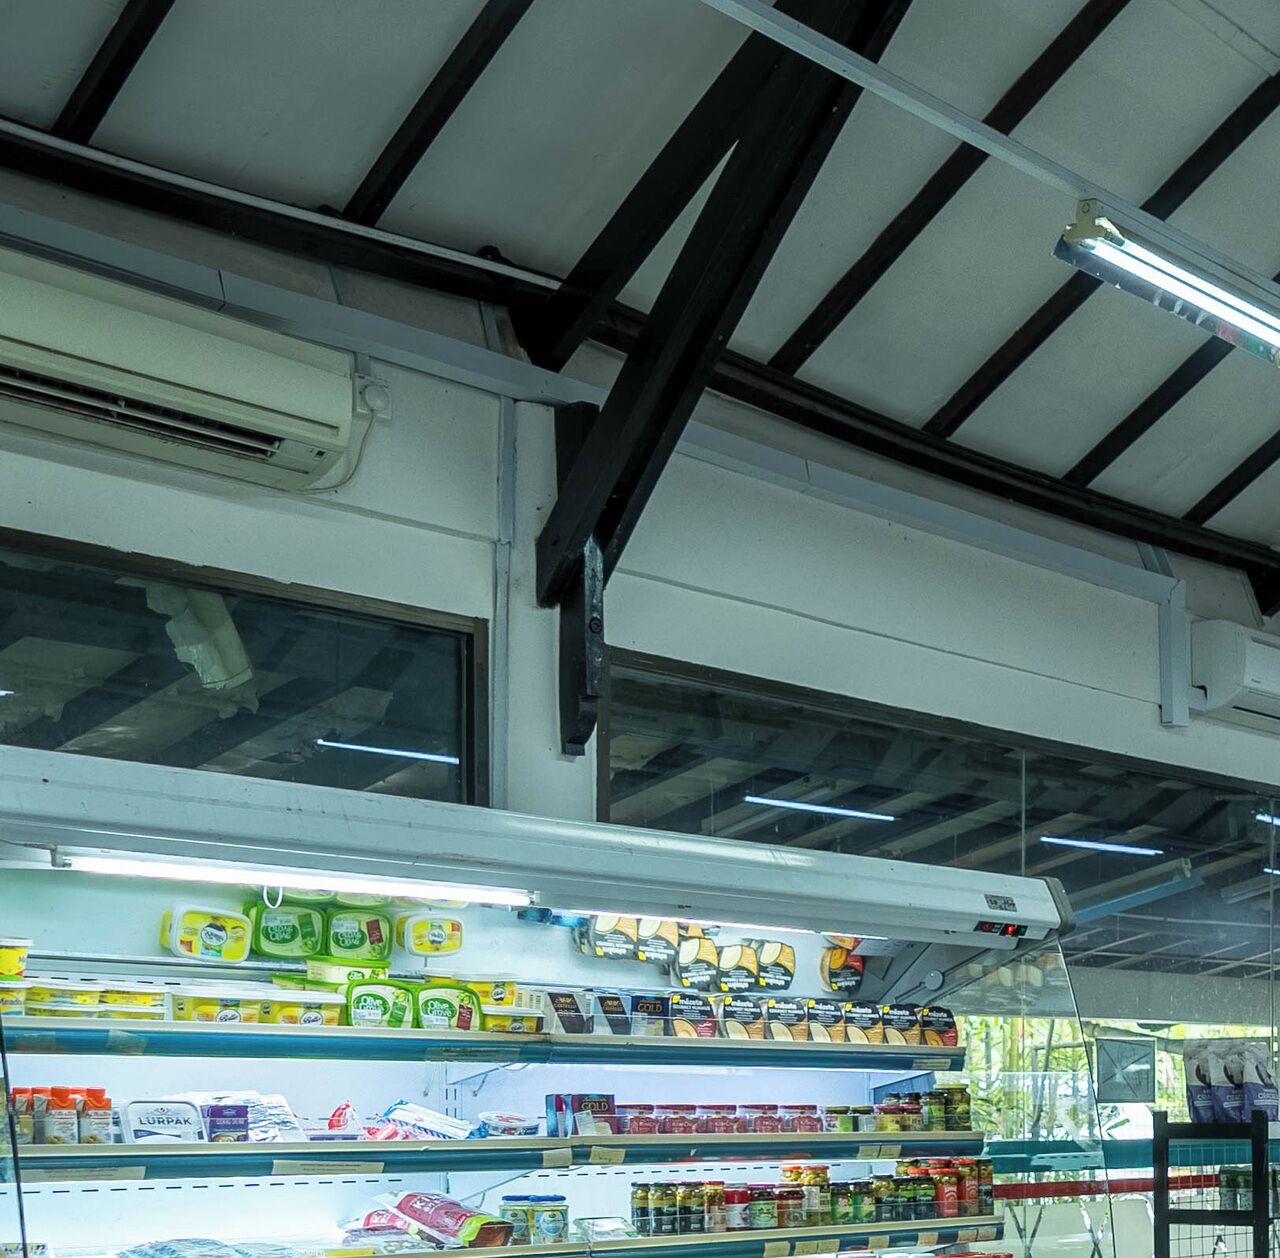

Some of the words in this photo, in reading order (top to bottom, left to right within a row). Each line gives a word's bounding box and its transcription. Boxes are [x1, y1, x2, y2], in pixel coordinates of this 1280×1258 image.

[361, 993, 383, 1006] Olive
[428, 1000, 449, 1010] Olive
[637, 1003, 663, 1013] GOLD
[580, 1102, 610, 1112] GOLD
[138, 1115, 193, 1127] LURPAK
